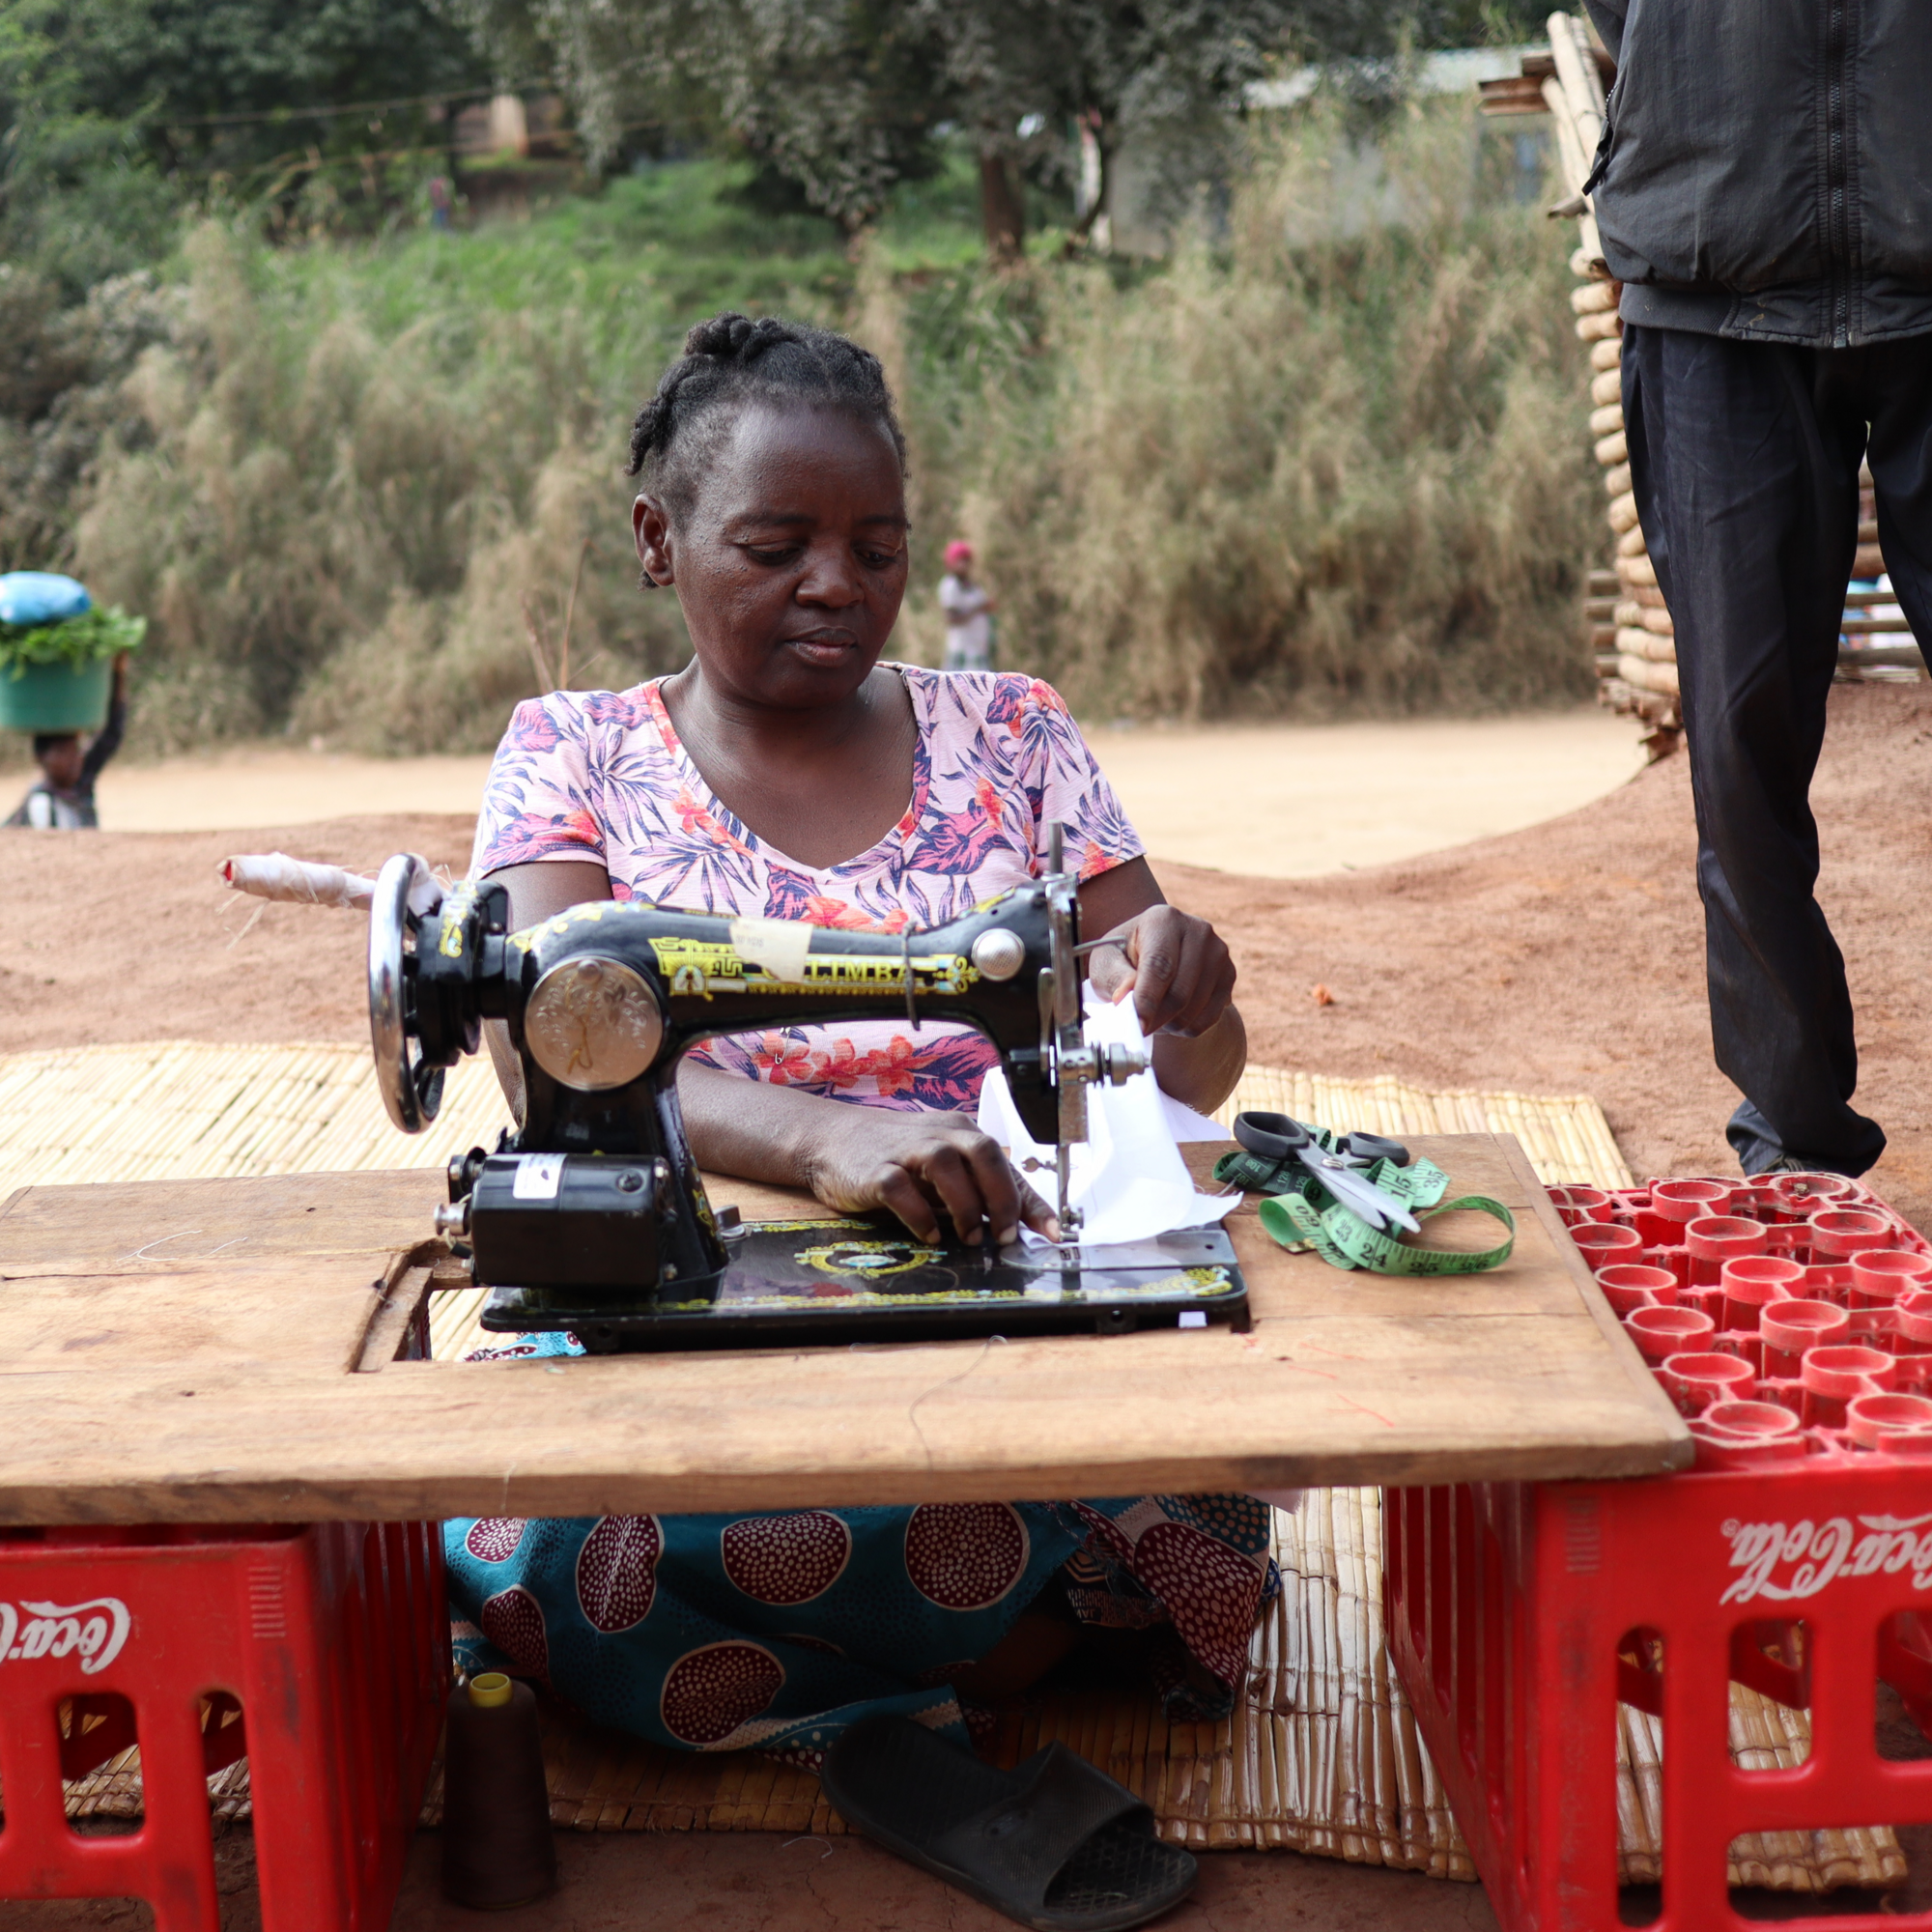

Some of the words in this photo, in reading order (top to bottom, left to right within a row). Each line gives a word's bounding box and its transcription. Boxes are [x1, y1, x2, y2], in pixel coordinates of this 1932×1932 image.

[1244, 1158, 1263, 1173] 108
[1276, 1170, 1292, 1184] 128
[1391, 1175, 1412, 1199] 15
[1423, 1170, 1445, 1189] 35
[1295, 1205, 1321, 1228] 60
[1335, 1218, 1352, 1242] 23
[1358, 1241, 1388, 1268] 24
[1406, 1261, 1439, 1273] 25
[0, 1597, 131, 1676] Coca-
